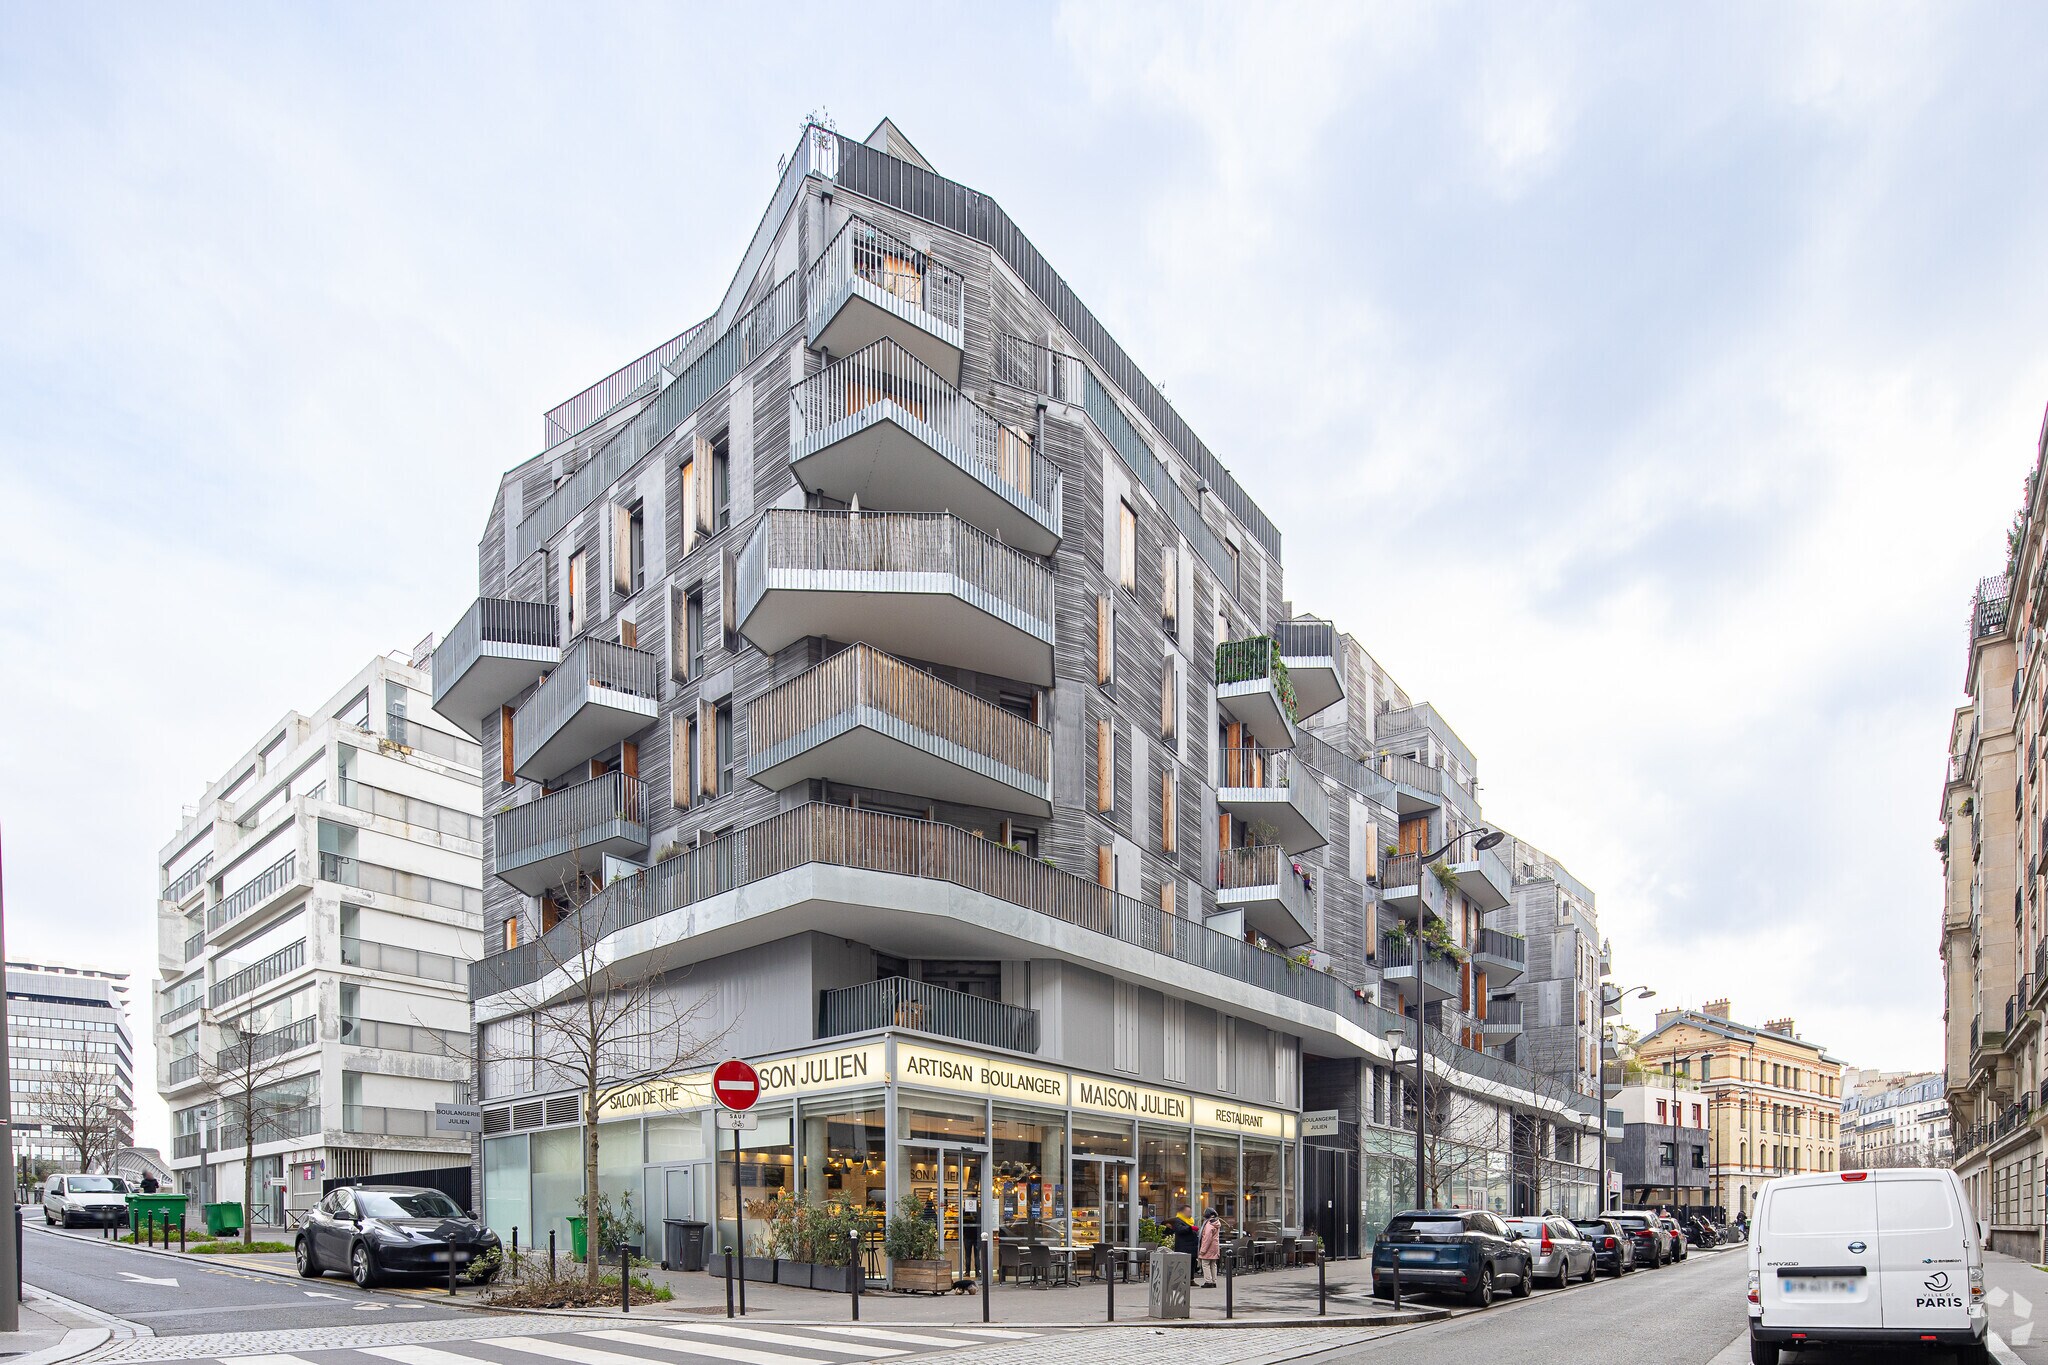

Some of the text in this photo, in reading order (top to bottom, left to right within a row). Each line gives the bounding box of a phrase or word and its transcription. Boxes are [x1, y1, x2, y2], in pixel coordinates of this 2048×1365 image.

[760, 1052, 867, 1090] SON JULIEN
[907, 1056, 1061, 1096] ARTISAN BOULANGER
[610, 1092, 641, 1110] SALON
[643, 1090, 656, 1105] DE
[1080, 1083, 1184, 1118] MAISON JULIEN
[436, 1109, 481, 1117] BOULANGERIE
[1215, 1109, 1263, 1128] RESTAURANT
[1302, 1115, 1337, 1123] BOULANGERIE
[1916, 1297, 1963, 1307] PARIS
